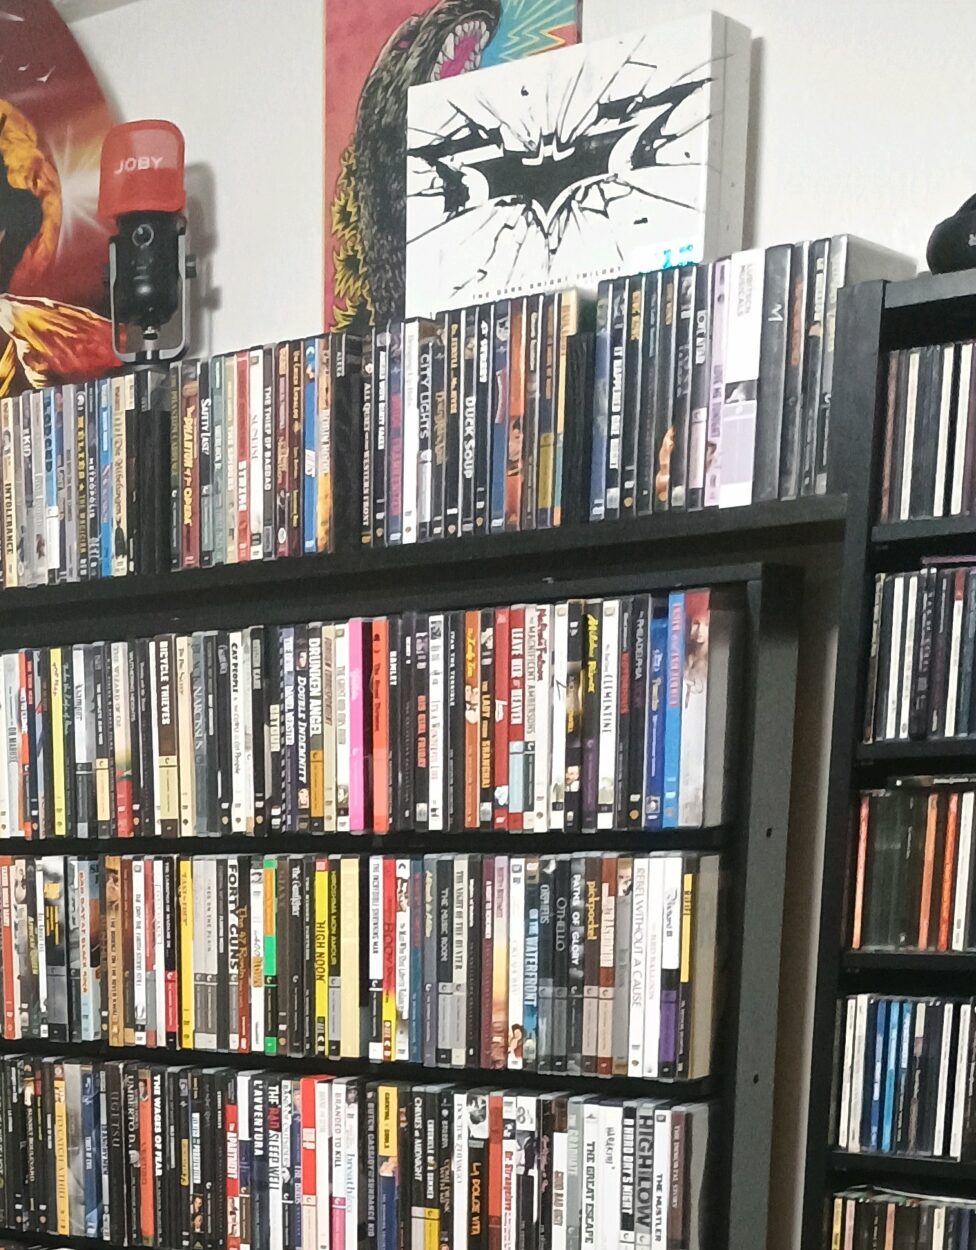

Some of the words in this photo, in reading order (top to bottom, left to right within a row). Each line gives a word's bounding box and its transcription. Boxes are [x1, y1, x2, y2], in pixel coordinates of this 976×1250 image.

[114, 155, 164, 175] JOBY
[768, 304, 783, 321] M
[420, 353, 429, 388] CITY
[420, 392, 429, 439] LIGHTS
[464, 396, 475, 438] DUCK
[464, 441, 475, 478] SOUP
[5, 483, 14, 554] INTOLERANCE
[161, 641, 170, 681] BICYCLE
[231, 643, 239, 660] CAT
[309, 638, 321, 696] DRUNKEN
[526, 626, 535, 682] MAGNIFICENT
[635, 619, 644, 679] PHILADELPHIA
[231, 662, 239, 692] PEOPLE
[297, 676, 307, 718] DOUBLE
[161, 685, 170, 724] THIEVES
[309, 699, 321, 737] ANGEL
[417, 695, 426, 711] HIS
[526, 685, 535, 734] AMBERSONS
[602, 675, 613, 733] CLEMENTINE
[417, 714, 426, 734] GIRL
[297, 721, 307, 784] INDEMNITY
[417, 737, 426, 767] FRIDAY
[228, 865, 238, 917] FORTY
[571, 875, 581, 906] PATHS
[587, 881, 598, 940] pickpocket
[556, 897, 566, 951] OTHELLO
[571, 912, 581, 926] OF
[228, 924, 238, 970] GUNS
[571, 931, 581, 965] GLORY
[127, 1076, 135, 1131] UMBERTO
[254, 1080, 263, 1155] L'AVVENTURA
[334, 1092, 342, 1135] BRANDED
[227, 1132, 239, 1179] APARTMENT
[334, 1137, 342, 1148] TO
[334, 1151, 342, 1167] KILL
[585, 1141, 595, 1162] THE
[637, 1115, 653, 1171] HIGH
[585, 1166, 595, 1201] GREAT
[637, 1178, 653, 1227] LOW
[655, 1174, 663, 1192] THE
[585, 1204, 595, 1244] ESCAPE
[655, 1196, 663, 1242] HUSTLER
